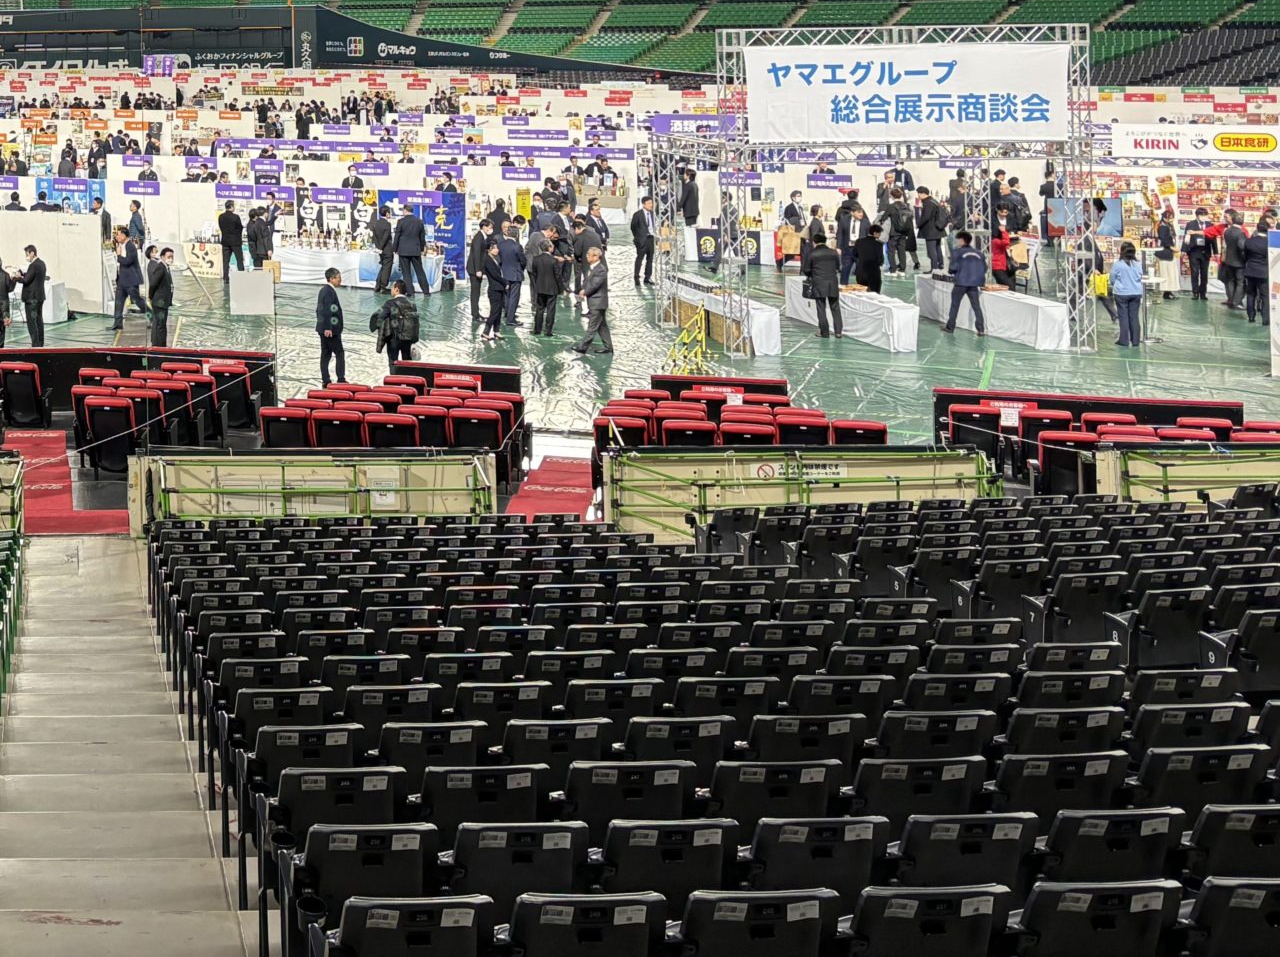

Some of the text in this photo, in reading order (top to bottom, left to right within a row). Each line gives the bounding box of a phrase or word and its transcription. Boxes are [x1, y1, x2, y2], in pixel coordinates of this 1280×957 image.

[387, 44, 416, 55] マルキョウ
[195, 52, 284, 60] ふくおかフィナンシャルグループ
[766, 59, 958, 88] ヤマエグループ
[830, 93, 1051, 124] 総合展示商談会
[1133, 138, 1180, 151] KIRIN
[1220, 137, 1269, 148] 日本食研
